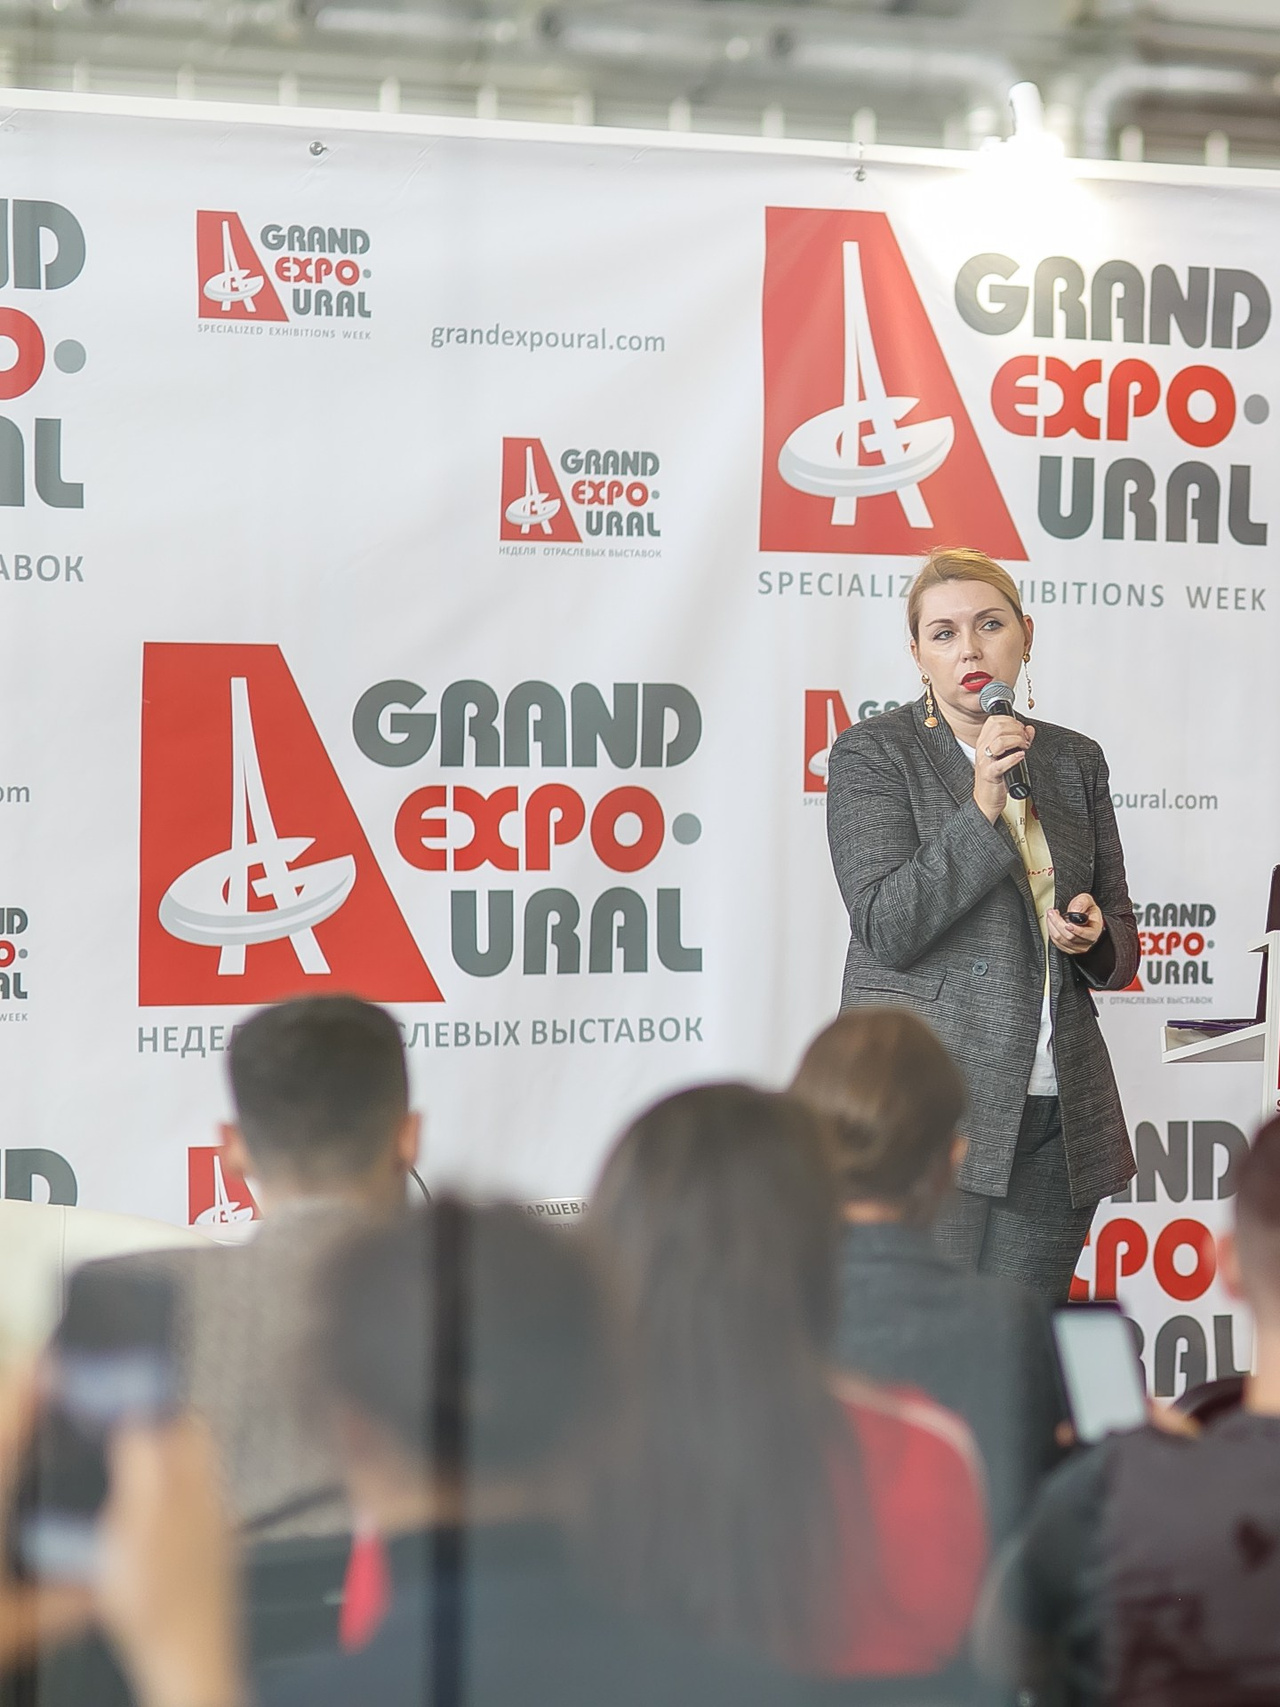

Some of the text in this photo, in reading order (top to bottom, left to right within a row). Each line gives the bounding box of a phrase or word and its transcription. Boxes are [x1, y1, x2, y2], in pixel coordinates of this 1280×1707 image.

[260, 224, 371, 255] GRAND
[275, 257, 360, 286] EXPO
[292, 288, 372, 318] URAL
[954, 252, 1272, 350] GRAND
[197, 323, 372, 340] SPECIALIZED EXHIBITIONS WEEK
[431, 323, 666, 352] grandexpoural.com
[990, 354, 1237, 448] EXPO
[560, 448, 660, 476] GRAND
[571, 480, 649, 507] EXPO
[1037, 455, 1269, 546] URAL
[585, 510, 661, 537] URAL
[499, 546, 536, 556] НЕДЕЛЯ
[758, 570, 914, 598] SPECIALIZ
[1186, 585, 1267, 611] WEEK
[352, 679, 703, 769] GRAND
[394, 783, 665, 873] EXPO
[451, 887, 703, 977] URAL
[1146, 960, 1214, 985] URAL
[531, 1016, 704, 1045] ВЫСТАВОК
